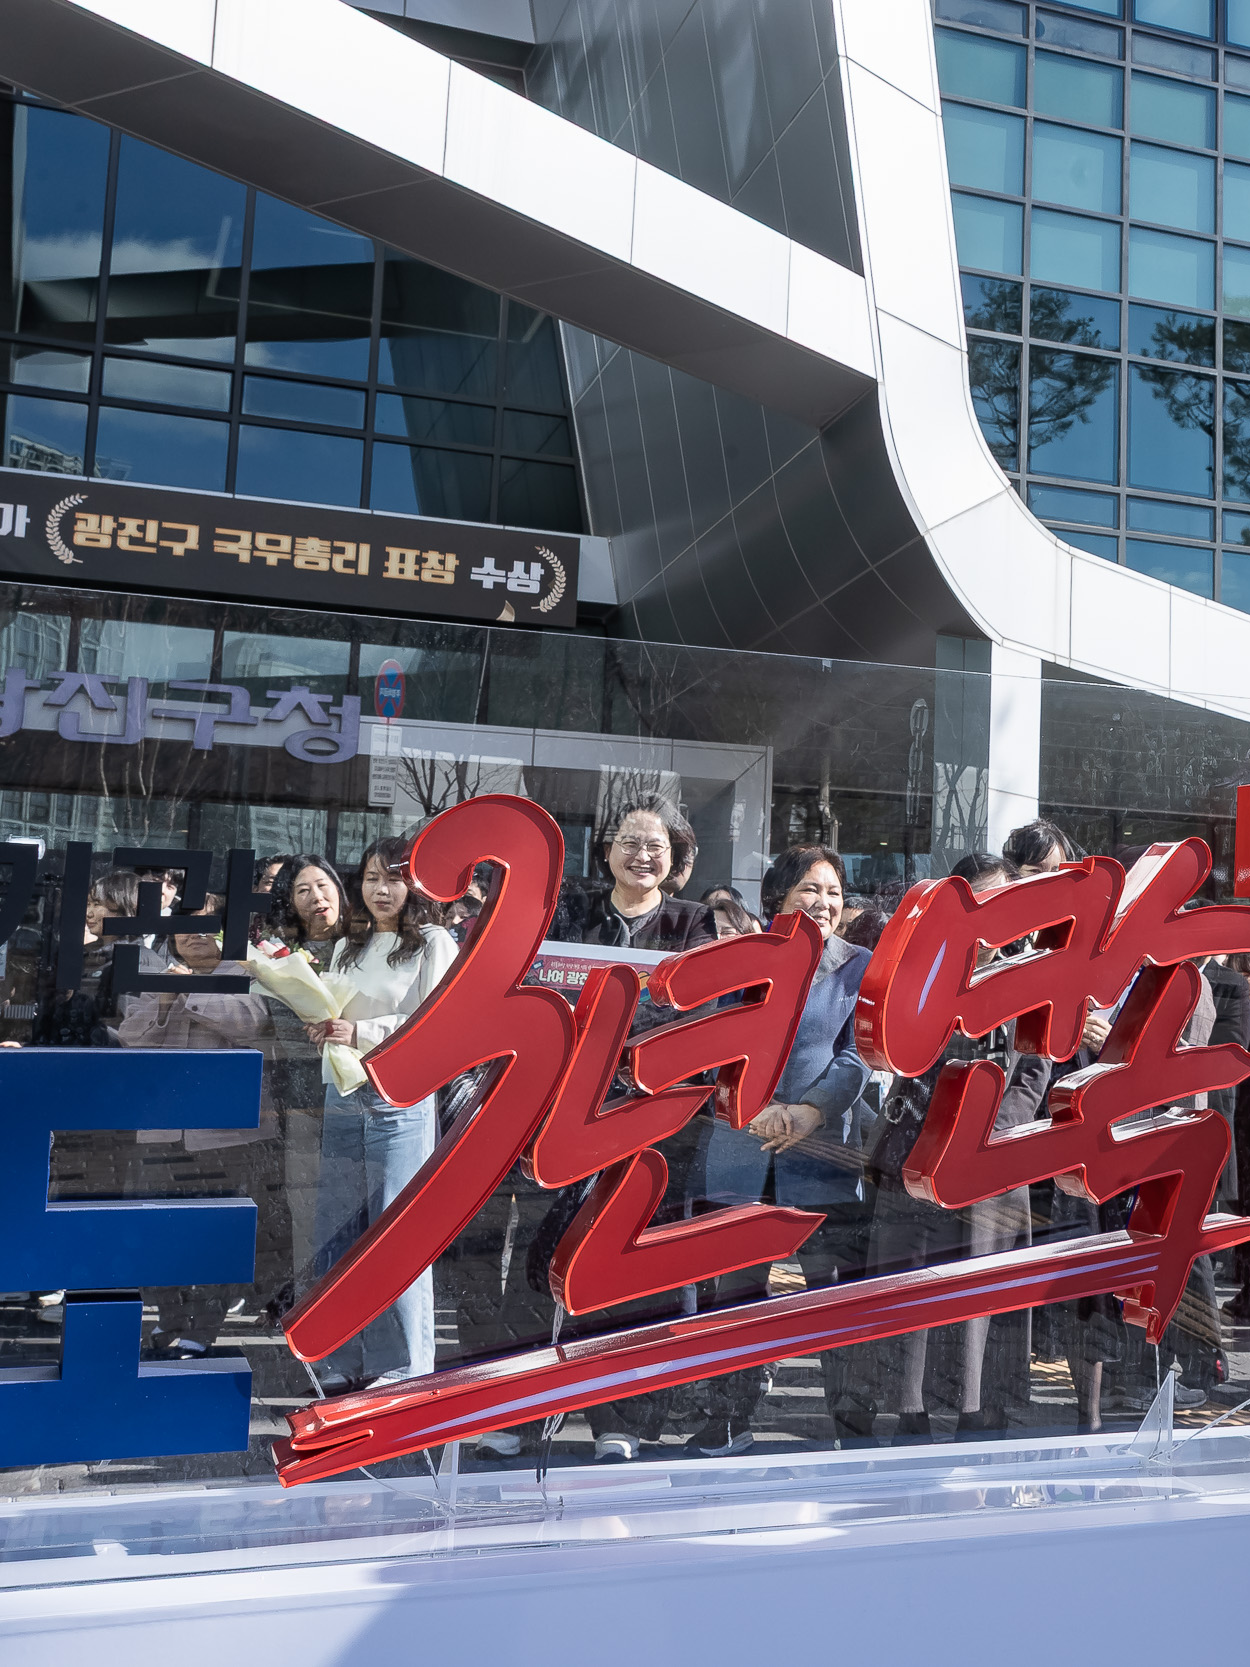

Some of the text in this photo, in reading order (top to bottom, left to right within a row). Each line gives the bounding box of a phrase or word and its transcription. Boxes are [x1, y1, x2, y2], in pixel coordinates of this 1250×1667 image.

[73, 511, 200, 557] 광진구
[213, 527, 371, 576] 국무총리
[382, 545, 460, 585] 표창
[470, 556, 545, 594] 수상
